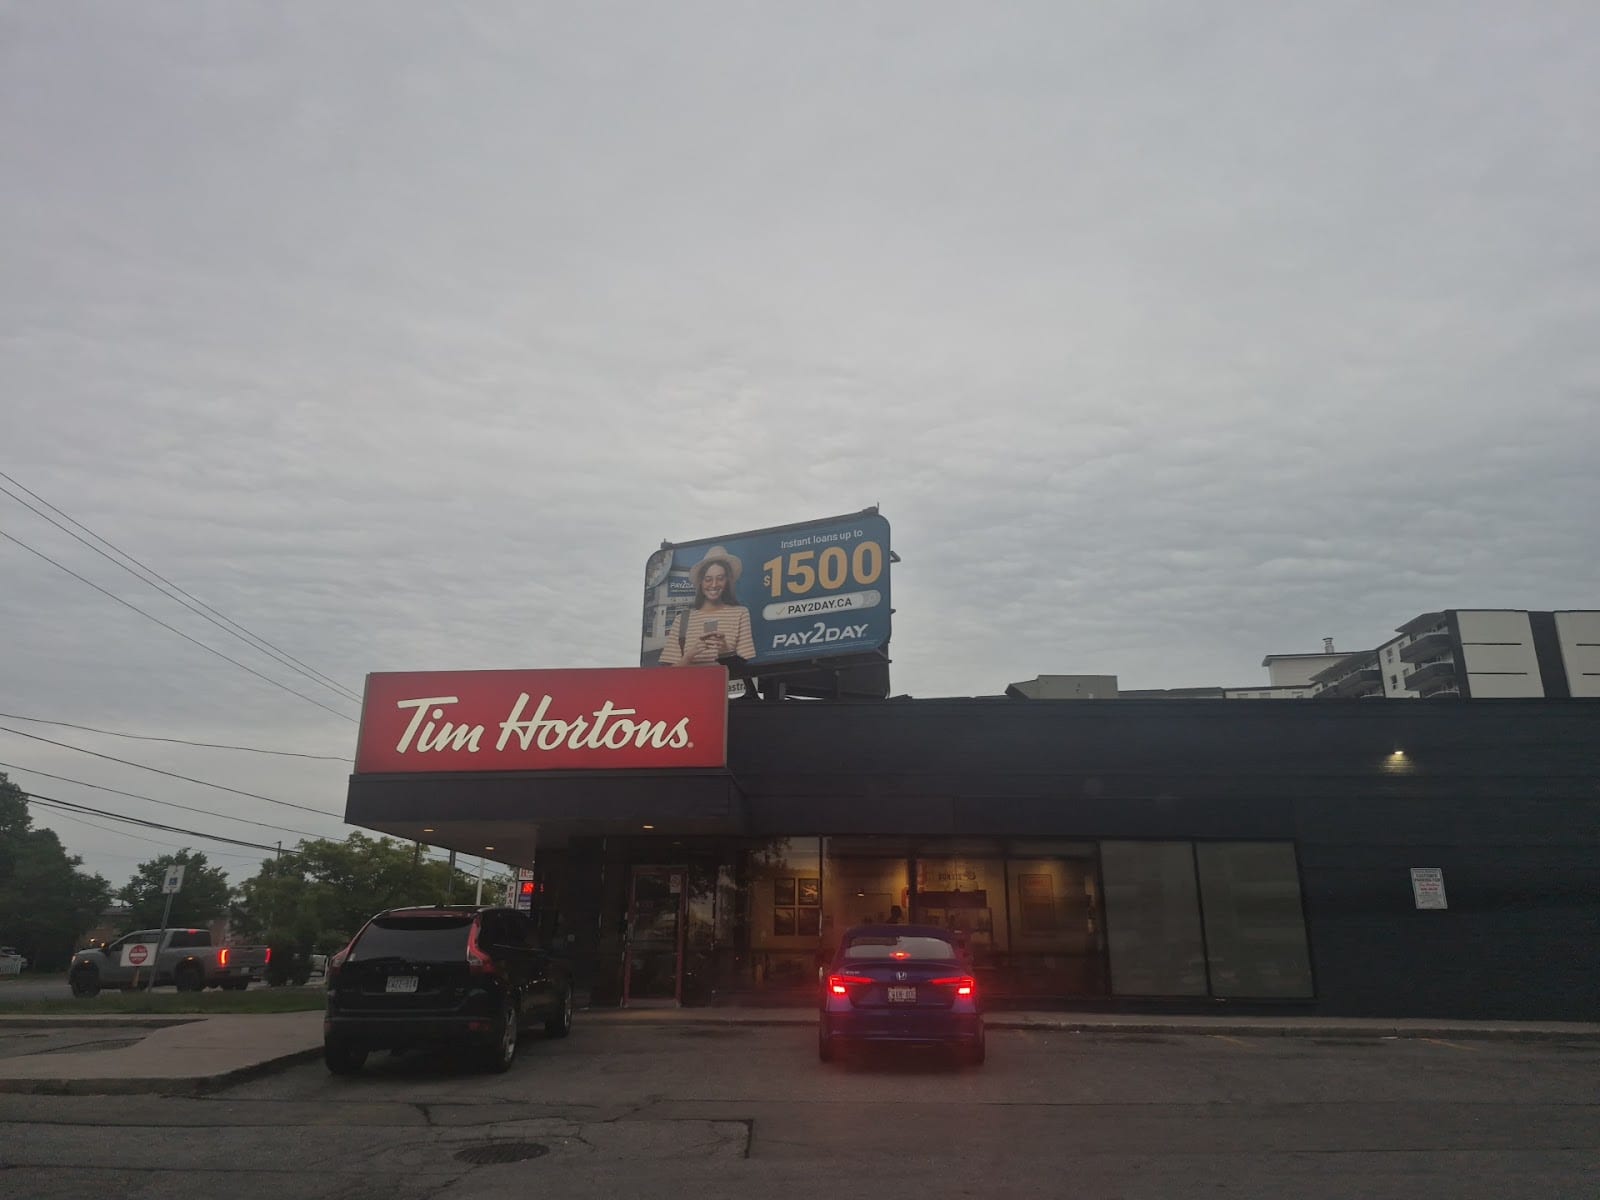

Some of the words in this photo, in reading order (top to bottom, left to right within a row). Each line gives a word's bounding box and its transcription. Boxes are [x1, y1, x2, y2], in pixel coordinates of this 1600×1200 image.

[781, 536, 811, 549] Instant
[813, 533, 838, 545] loans
[839, 531, 852, 543] up
[854, 529, 863, 538] to
[788, 598, 852, 615] PAY2DAY.CA
[772, 622, 869, 648] PAY2DAY
[396, 695, 485, 754] Tim
[495, 692, 691, 752] Hortons
